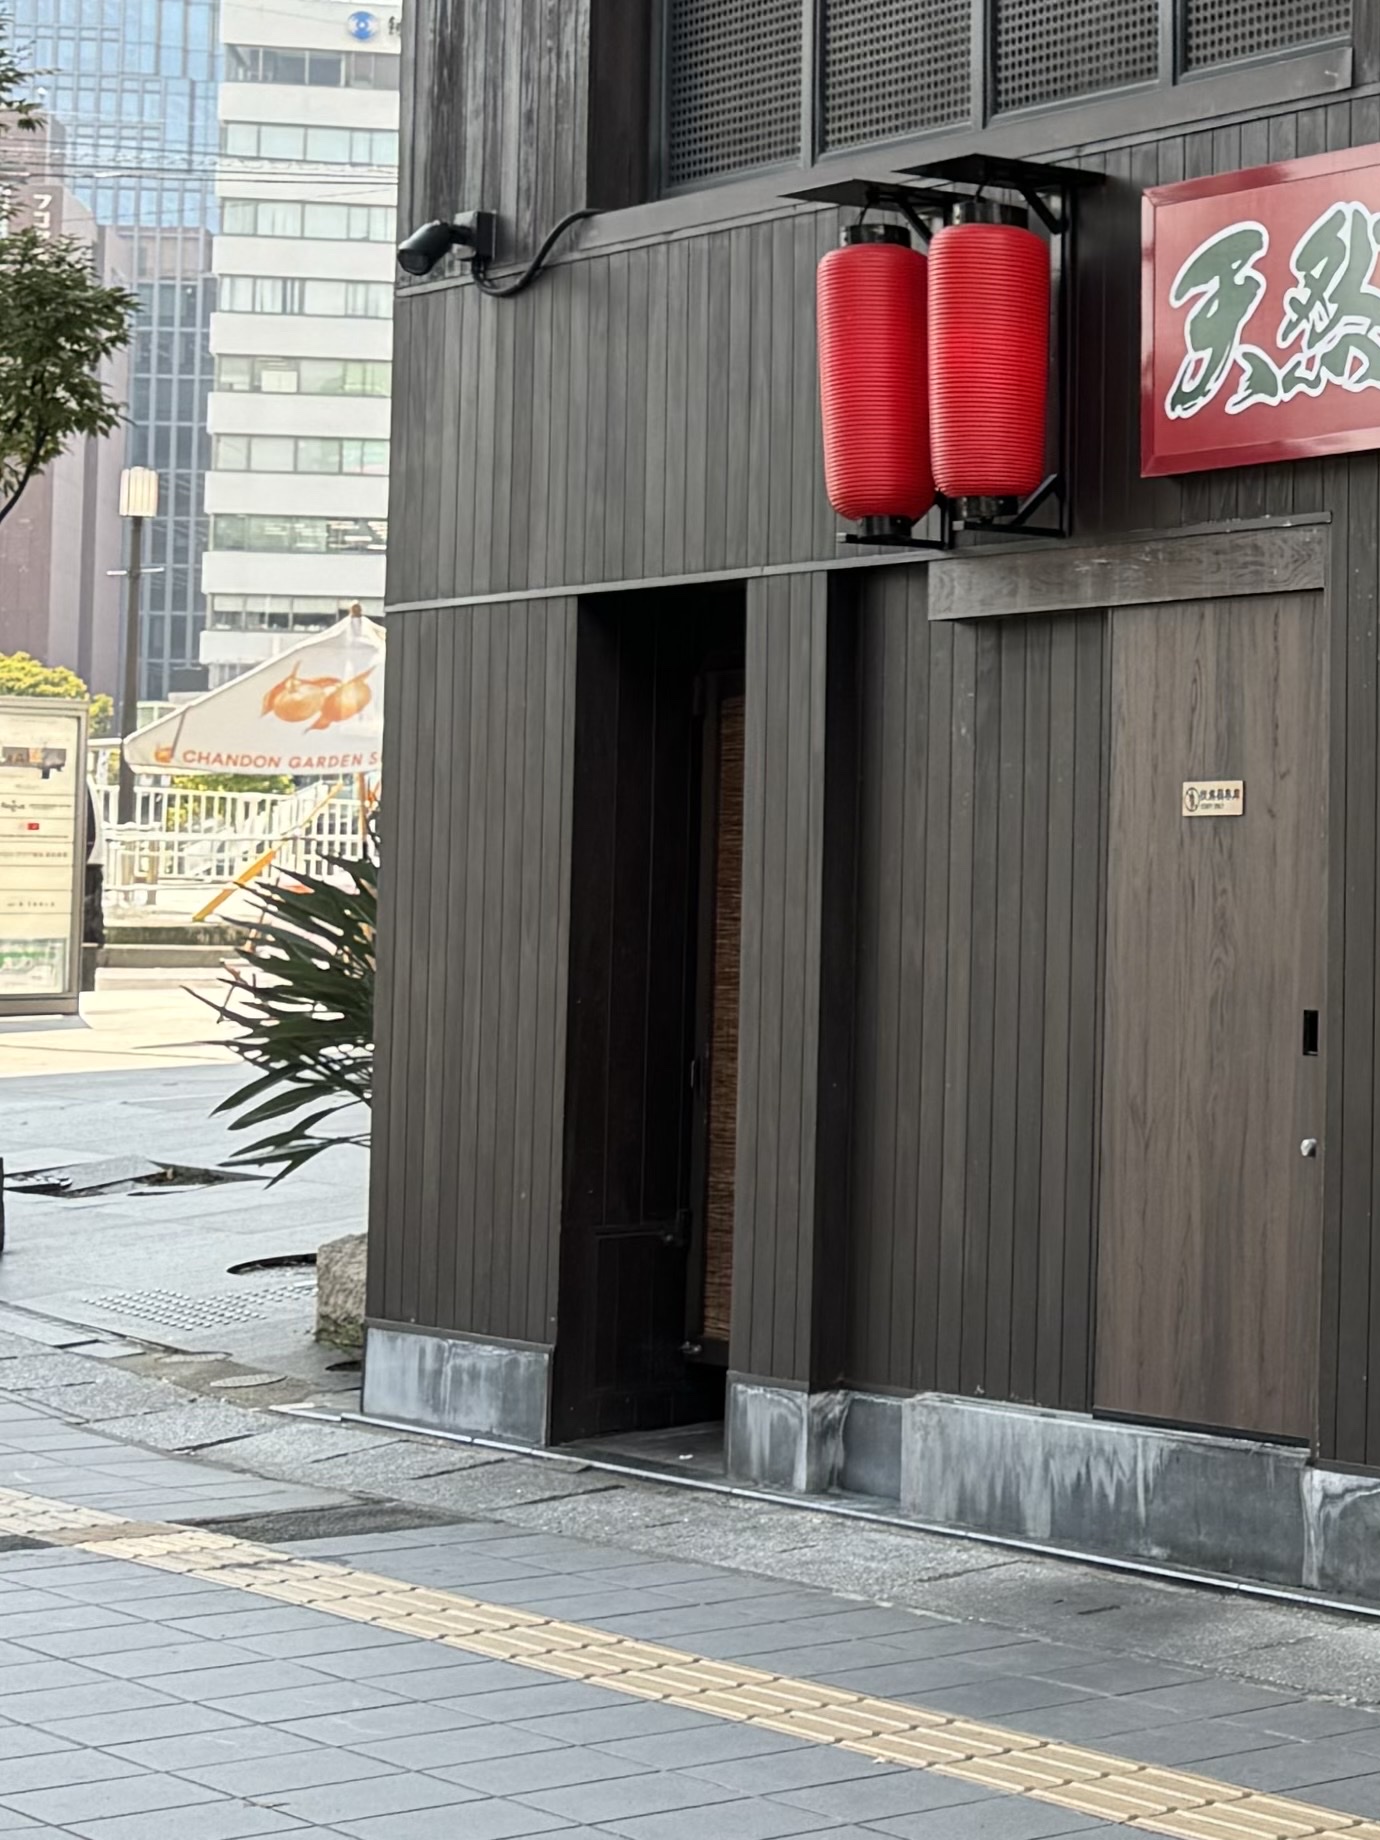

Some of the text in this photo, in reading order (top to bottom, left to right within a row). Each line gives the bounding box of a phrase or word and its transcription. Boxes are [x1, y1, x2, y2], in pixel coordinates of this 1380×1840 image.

[182, 749, 379, 769] CHANDON GARDEN S
